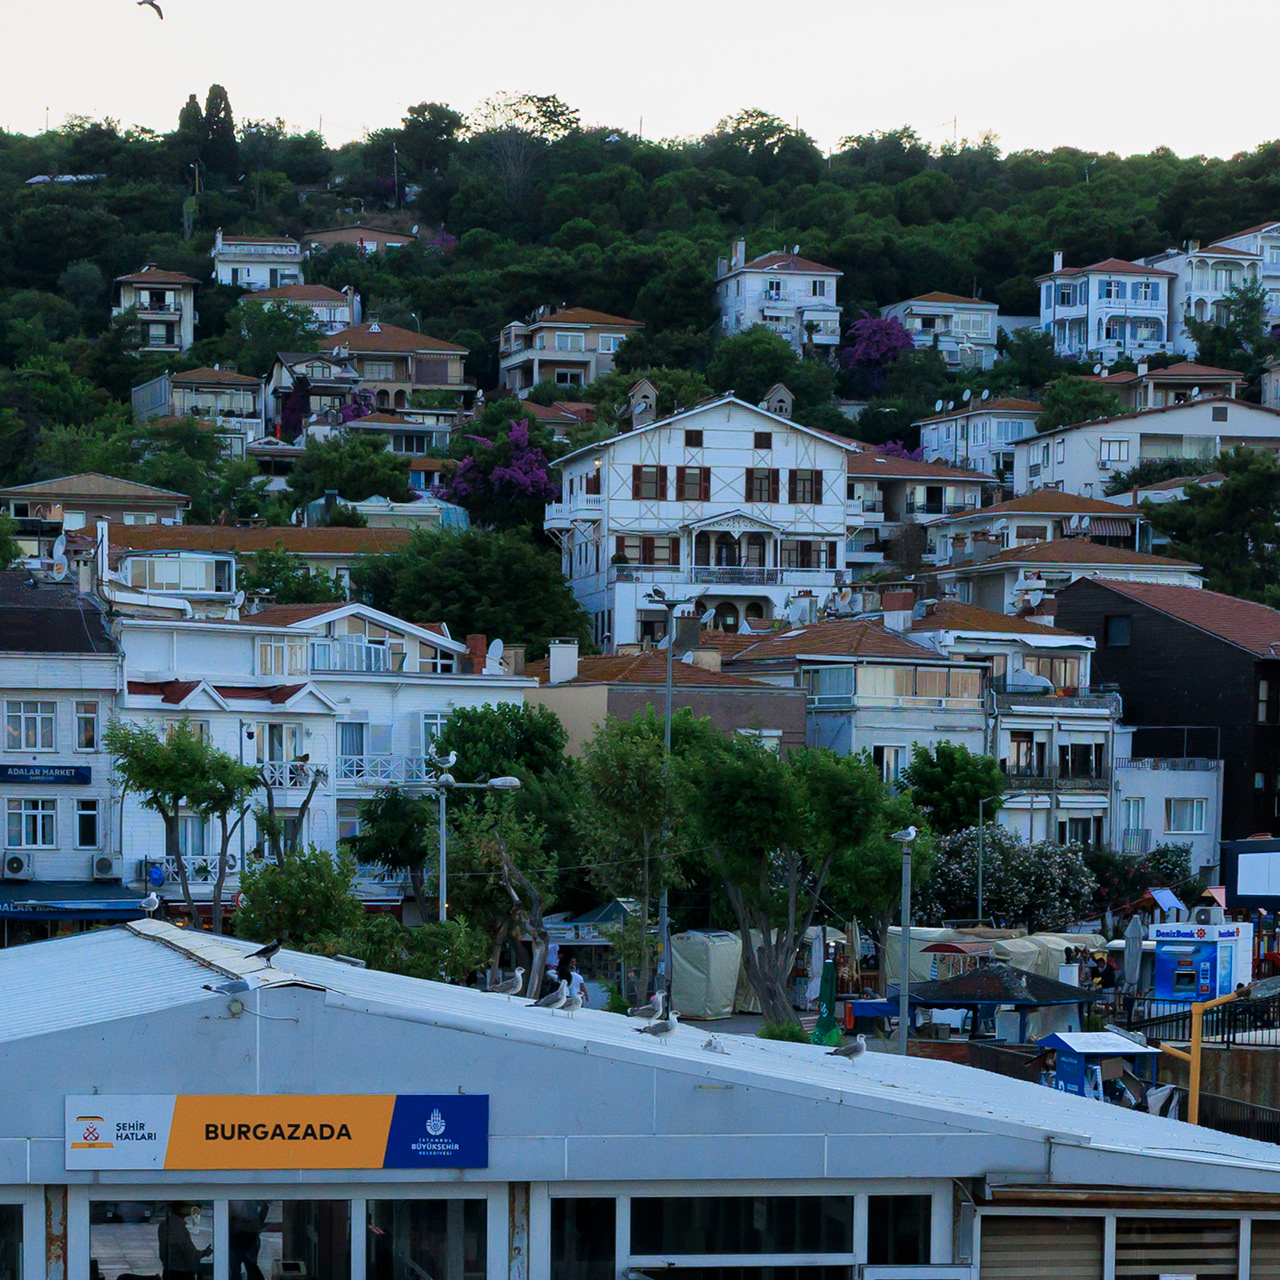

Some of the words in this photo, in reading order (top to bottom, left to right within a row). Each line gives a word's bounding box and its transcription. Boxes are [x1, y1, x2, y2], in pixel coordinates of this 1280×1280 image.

[7, 768, 41, 776] ADALAR
[42, 769, 76, 777] MARKET
[1155, 929, 1195, 938] DenizBank
[115, 1120, 145, 1132] ŞEHİR
[115, 1132, 157, 1141] HATLARI
[204, 1123, 353, 1141] BURGAZADA
[411, 1142, 460, 1151] BÜYÜKŞEHİR
